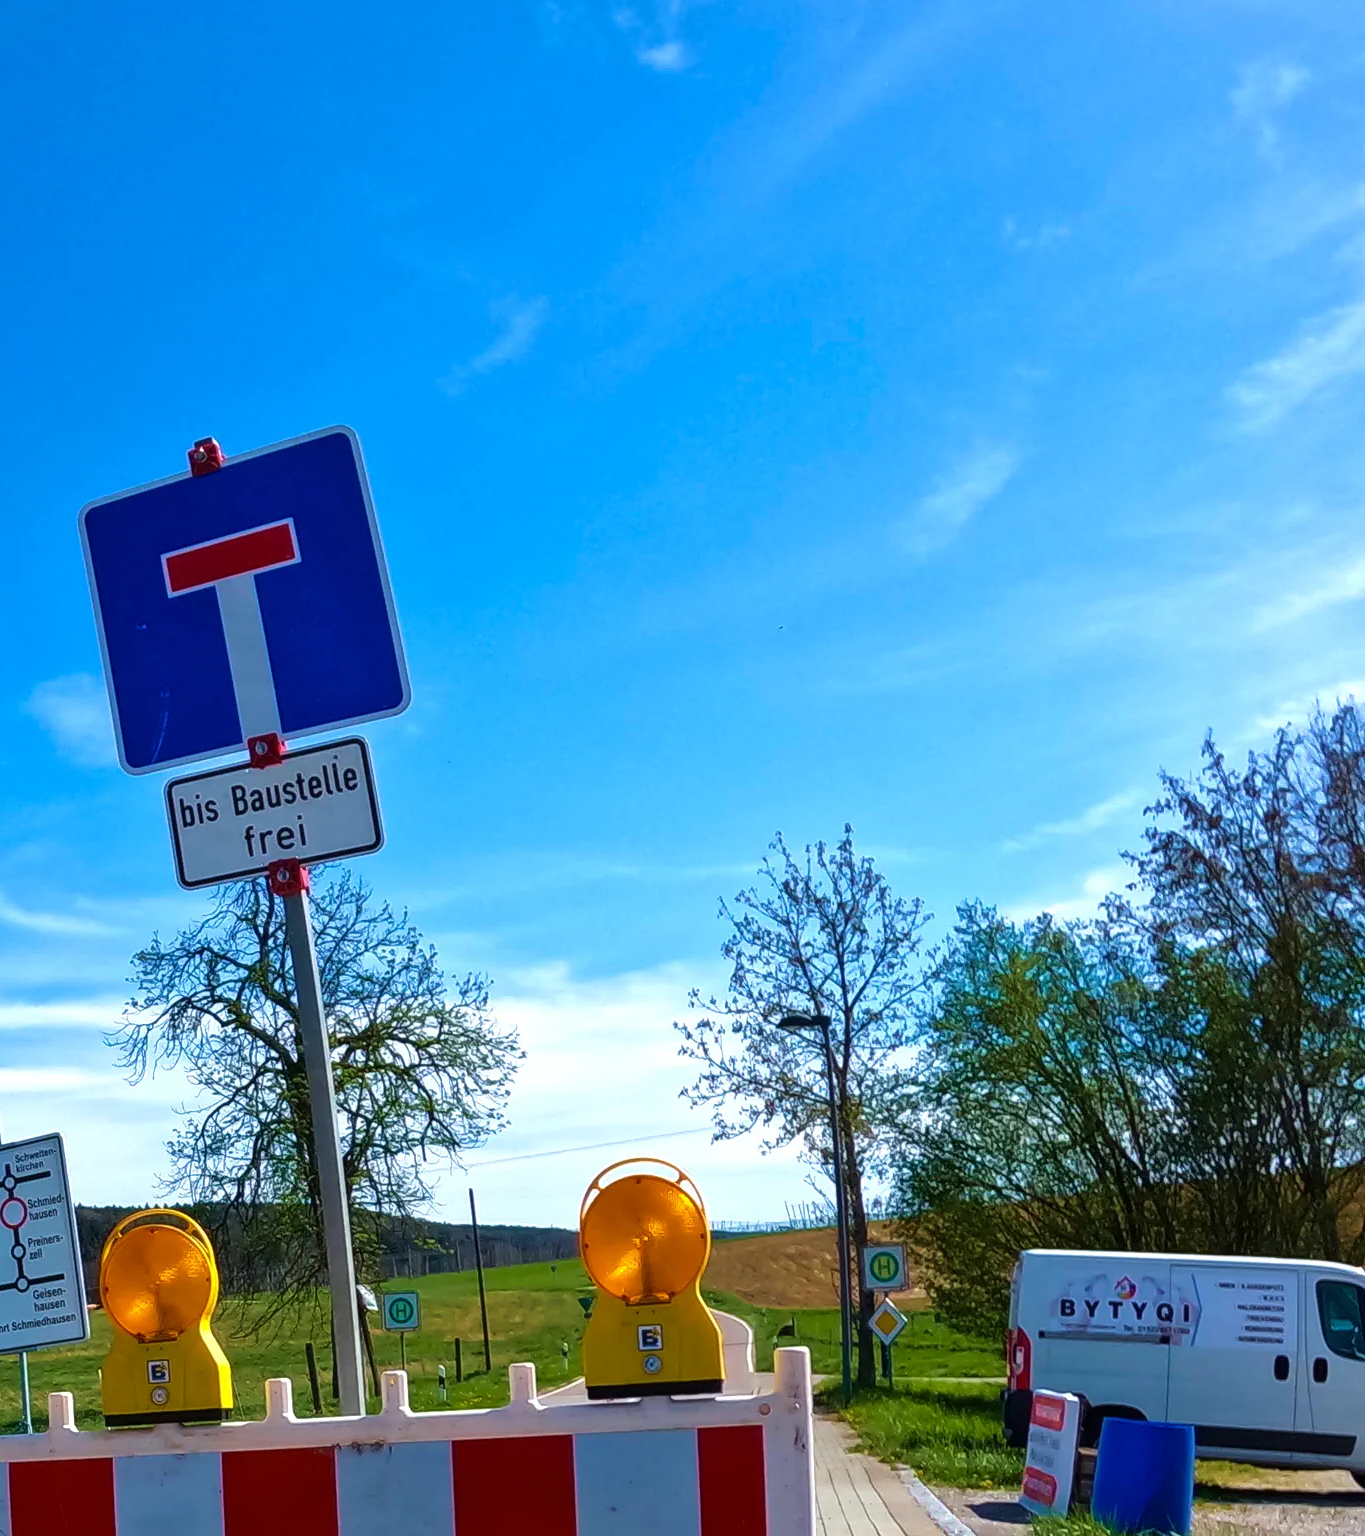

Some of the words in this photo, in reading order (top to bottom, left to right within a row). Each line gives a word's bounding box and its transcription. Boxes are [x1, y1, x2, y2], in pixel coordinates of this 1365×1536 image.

[179, 794, 219, 828] bis
[230, 762, 359, 817] Baustelle
[243, 815, 307, 857] frei
[15, 1148, 57, 1163] Schweiten-
[16, 1161, 45, 1173] kirchen
[27, 1193, 65, 1208] Schmied-
[29, 1208, 58, 1221] hausen
[28, 1234, 64, 1248] Preiners-
[29, 1249, 43, 1261] zell
[32, 1287, 66, 1300] Geisen-
[33, 1299, 66, 1312] hausen
[1059, 1298, 1191, 1323] BYTYQI
[12, 1313, 77, 1331] Schmiedhausen
